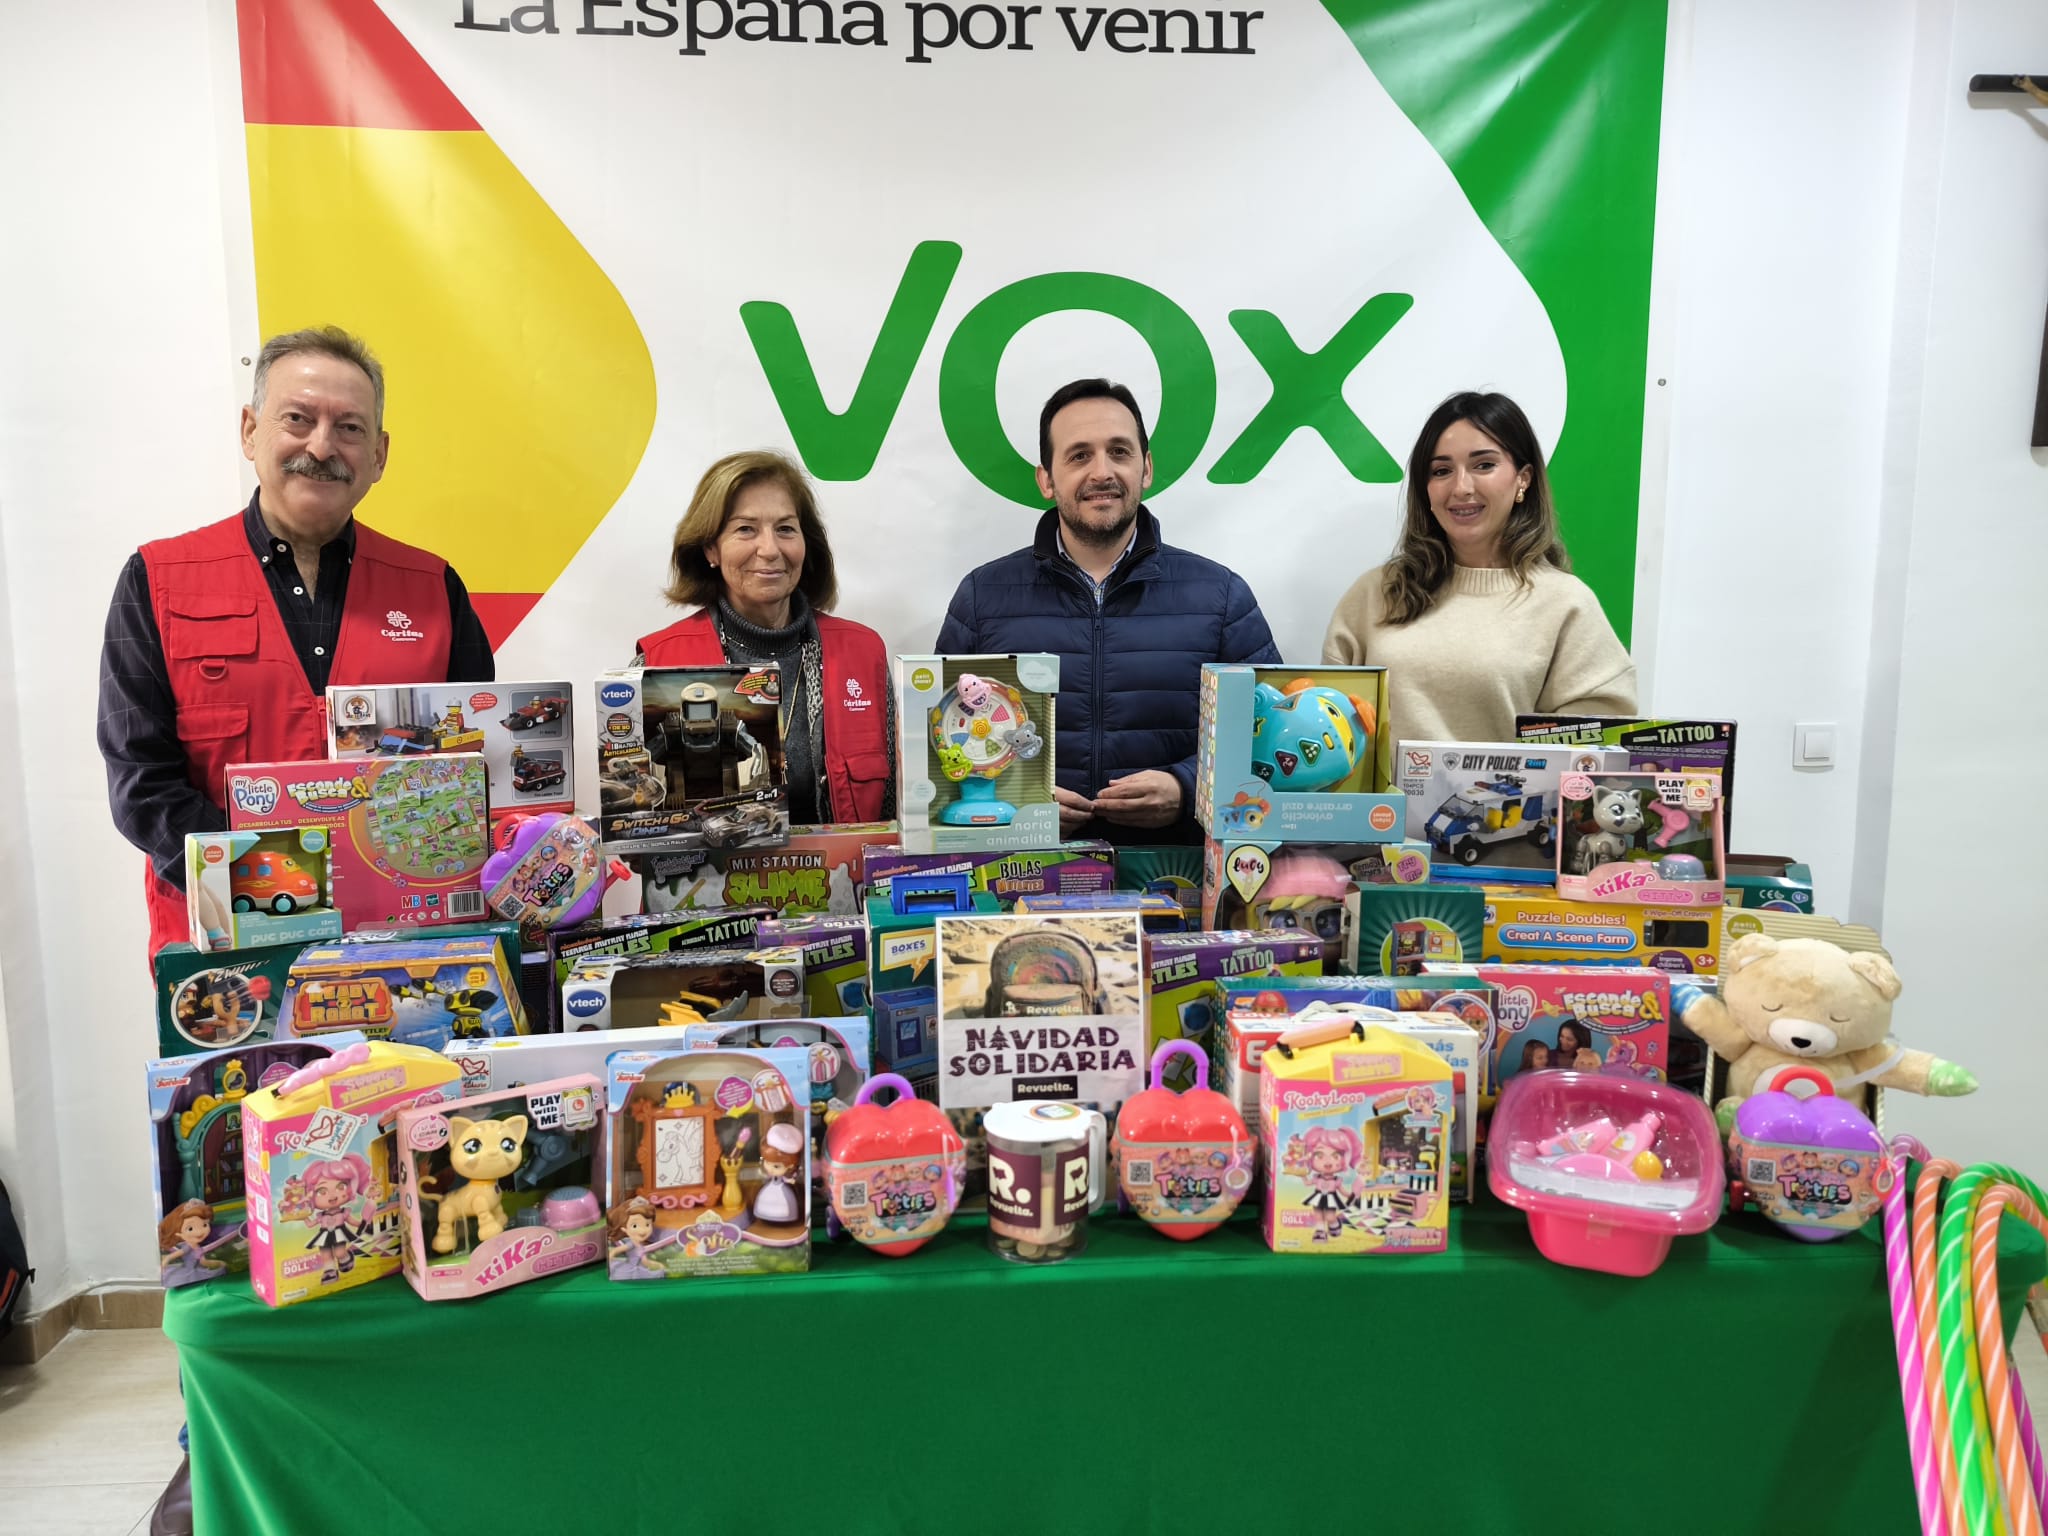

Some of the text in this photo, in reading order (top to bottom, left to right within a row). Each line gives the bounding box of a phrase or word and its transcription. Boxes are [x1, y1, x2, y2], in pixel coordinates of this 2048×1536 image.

[906, 0, 1041, 63] por
[1055, 0, 1264, 55] venir
[740, 240, 1414, 510] VOX
[602, 688, 634, 698] vtech
[1657, 725, 1715, 744] TATTOO
[1462, 754, 1486, 770] CITY
[1486, 756, 1522, 771] POLICE
[248, 784, 273, 795] little
[1658, 779, 1685, 788] PLAY
[234, 788, 276, 813] Pony
[756, 790, 764, 801] 2
[771, 788, 778, 798] 1
[1665, 794, 1682, 802] ME
[1014, 818, 1052, 832] noria
[986, 832, 1052, 847] animalito
[732, 854, 823, 870] MIX STATION
[1000, 860, 1043, 879] BOLAS
[725, 868, 828, 905] SLIME
[401, 894, 421, 909] MB
[1517, 911, 1626, 926] Puzzle Doubles!
[251, 933, 276, 945] puc
[279, 929, 304, 942] puc
[307, 926, 338, 938] cars
[1506, 930, 1629, 945] Creat A Scene Farm
[891, 939, 926, 954] BOXES
[1220, 949, 1275, 976] TATTOO
[1697, 955, 1715, 966] 3+
[568, 996, 604, 1008] vtech
[1498, 1006, 1531, 1031] ony
[949, 1049, 1137, 1077] SOLIDARIA
[1017, 1081, 1074, 1094] Revuelta.
[530, 1094, 561, 1109] PLAY
[534, 1106, 558, 1116] with
[540, 1114, 559, 1126] ME
[283, 1263, 310, 1276] DOLL
